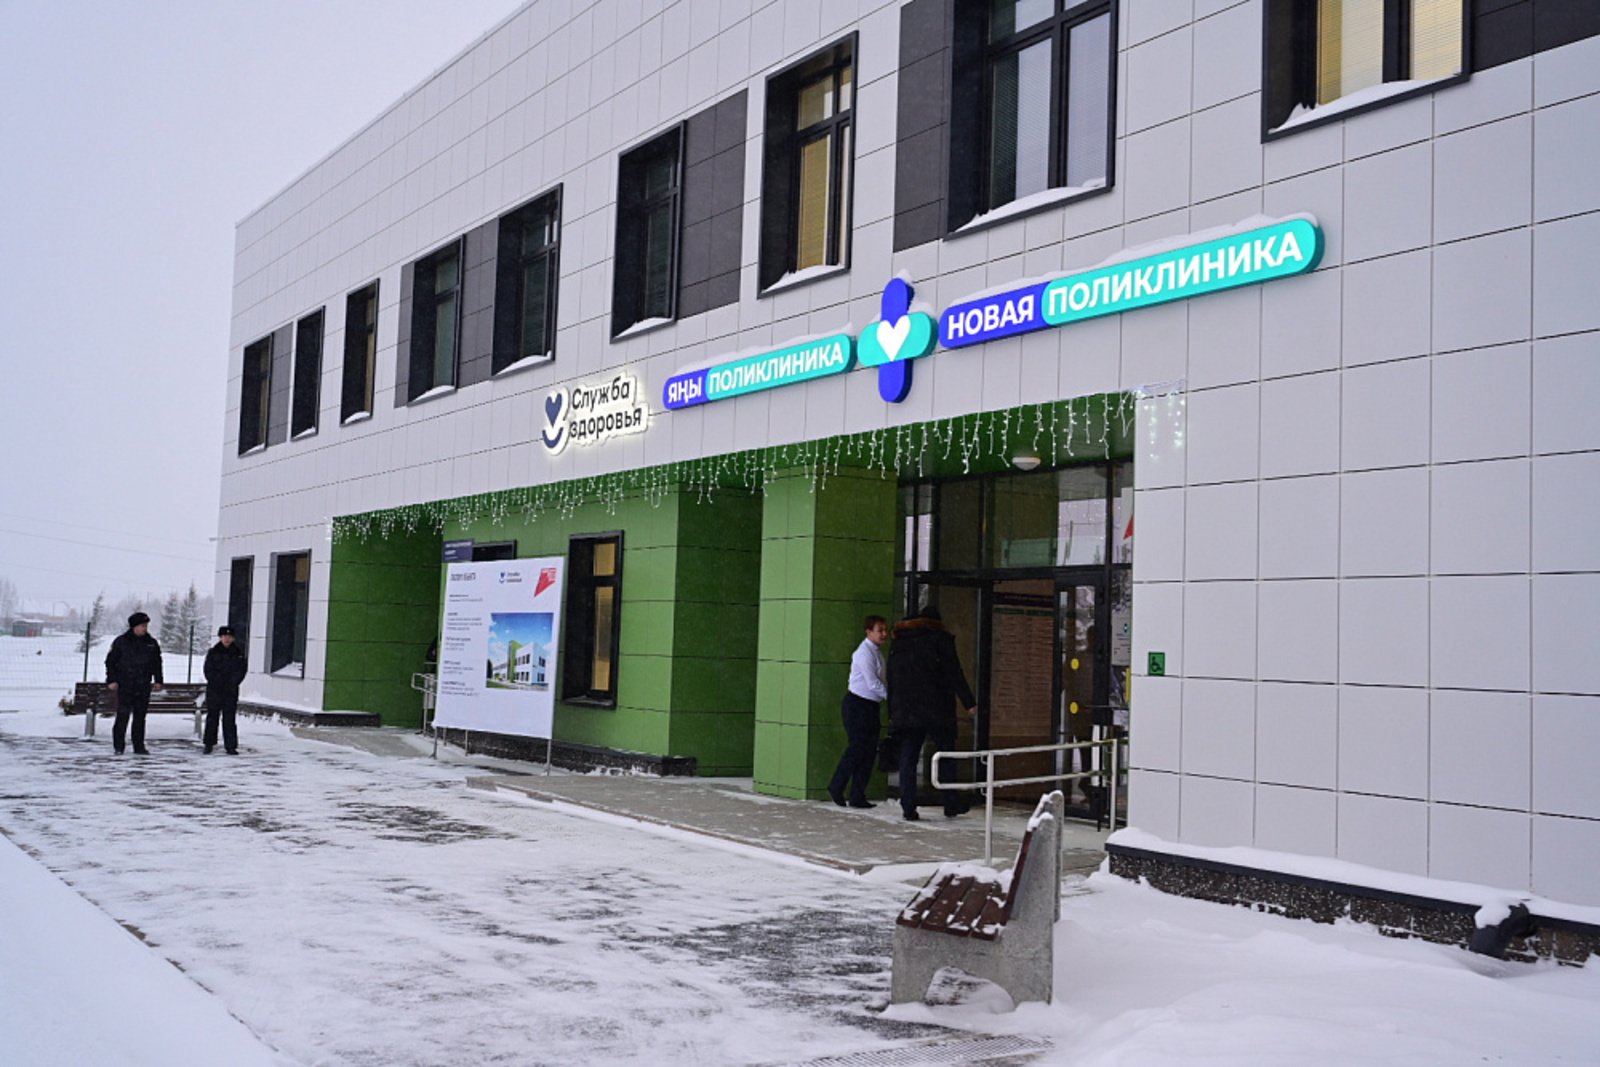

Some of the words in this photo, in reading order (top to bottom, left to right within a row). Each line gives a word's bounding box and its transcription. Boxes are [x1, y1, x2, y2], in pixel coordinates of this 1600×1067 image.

[947, 295, 1035, 340] НОВАЯ
[1048, 231, 1303, 316] ПОЛИКЛИНИКА
[572, 376, 630, 412] Служба
[668, 377, 702, 403] ЯҢЫ
[709, 342, 844, 393] ПОЛИКЛИНИКА
[569, 407, 642, 440] здоровья
